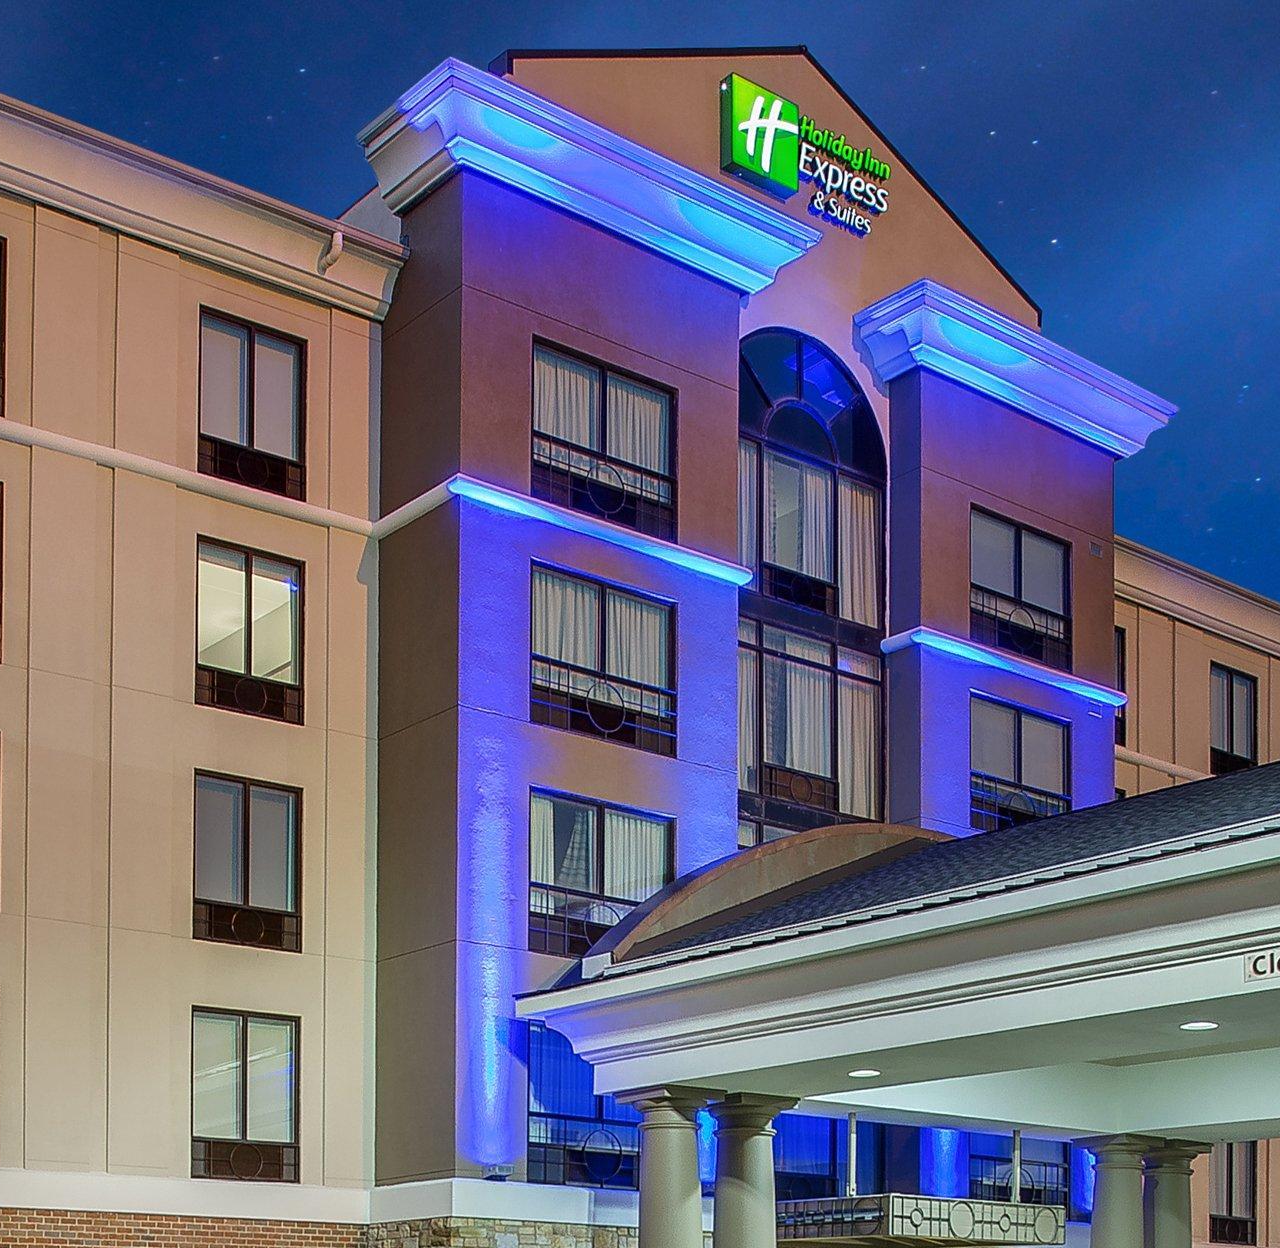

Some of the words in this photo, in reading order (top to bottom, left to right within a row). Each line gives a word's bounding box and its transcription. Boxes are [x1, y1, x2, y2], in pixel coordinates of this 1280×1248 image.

[799, 141, 890, 213] Express
[800, 115, 864, 170] Holiday
[864, 148, 892, 180] Inn
[814, 191, 825, 214] &
[827, 197, 872, 234] Suites
